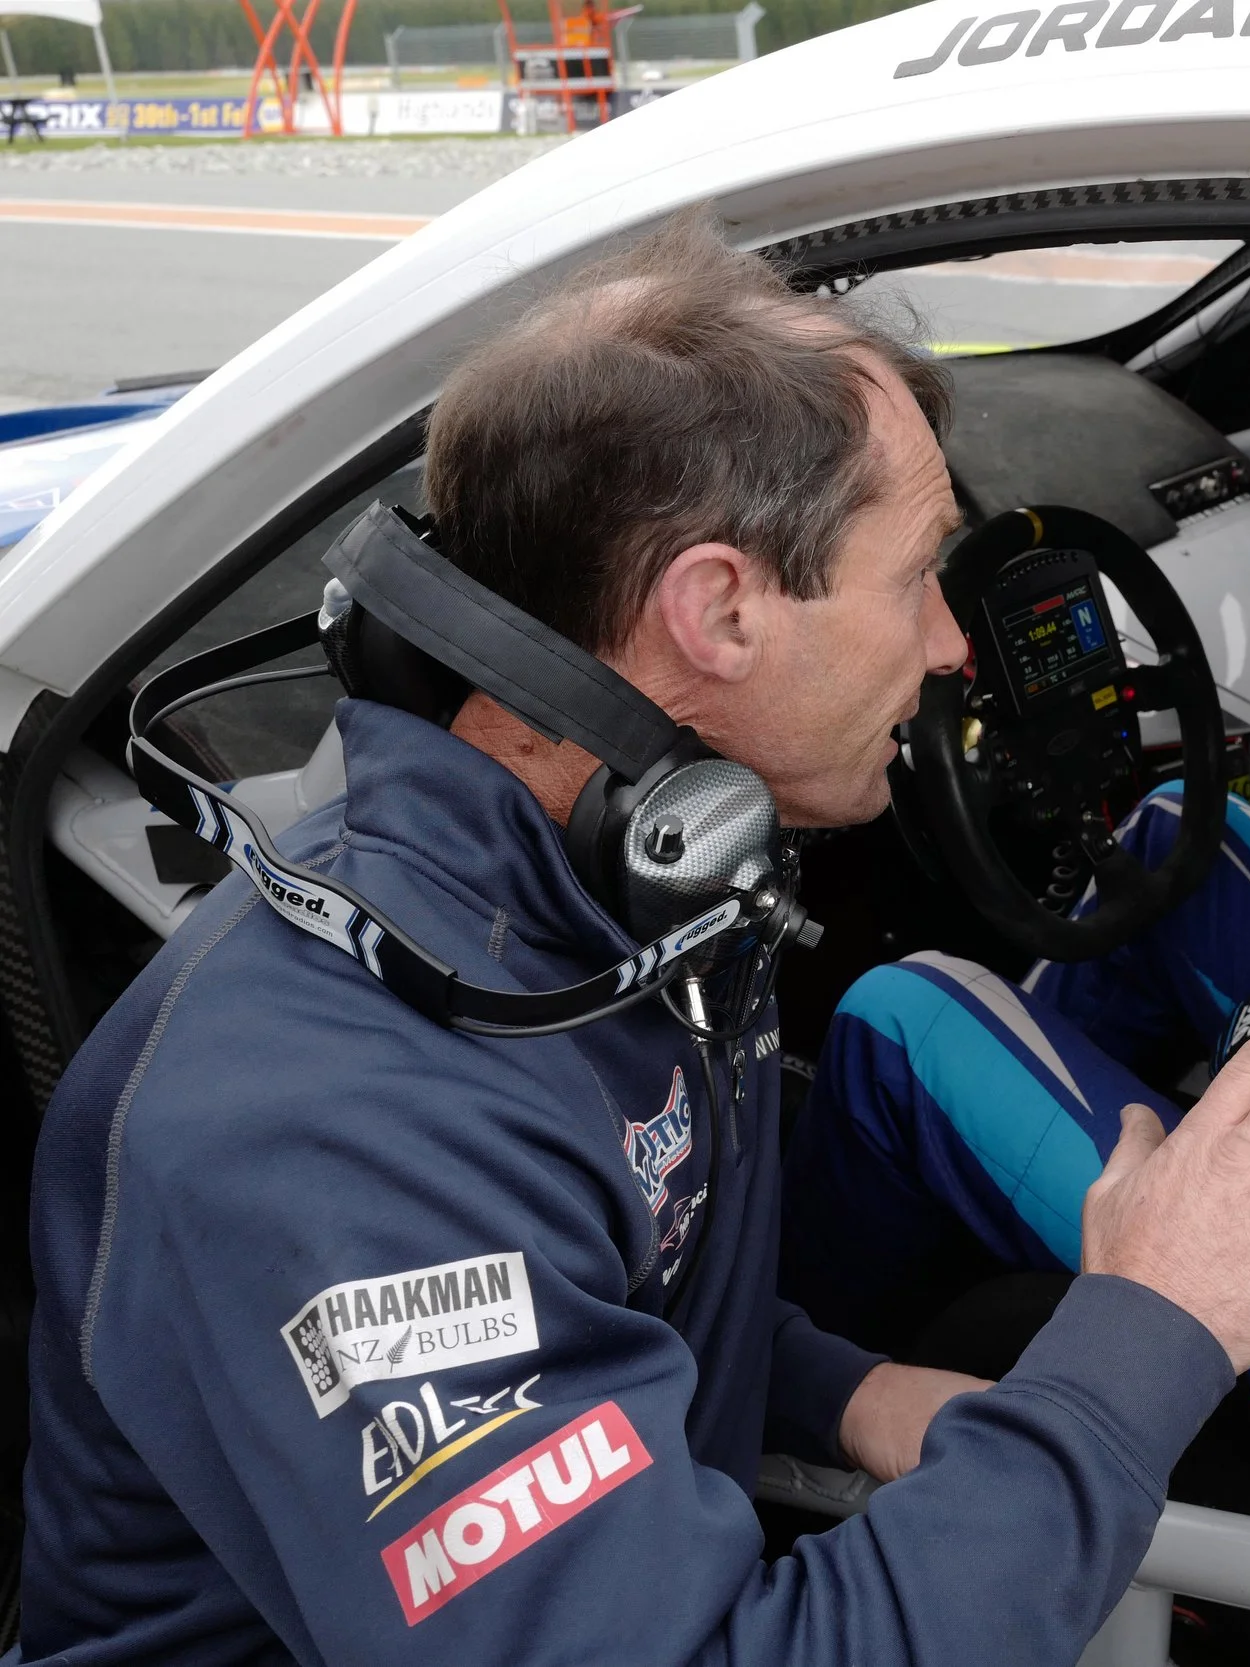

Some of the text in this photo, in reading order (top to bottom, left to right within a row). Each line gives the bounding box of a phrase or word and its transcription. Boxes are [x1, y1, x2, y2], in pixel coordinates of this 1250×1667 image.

[1078, 606, 1093, 628] N
[680, 909, 728, 944] rugged.
[326, 1261, 513, 1337] HAAKMAN
[336, 1312, 518, 1373] NZ BULBS
[404, 1420, 632, 1609] MOTUL
